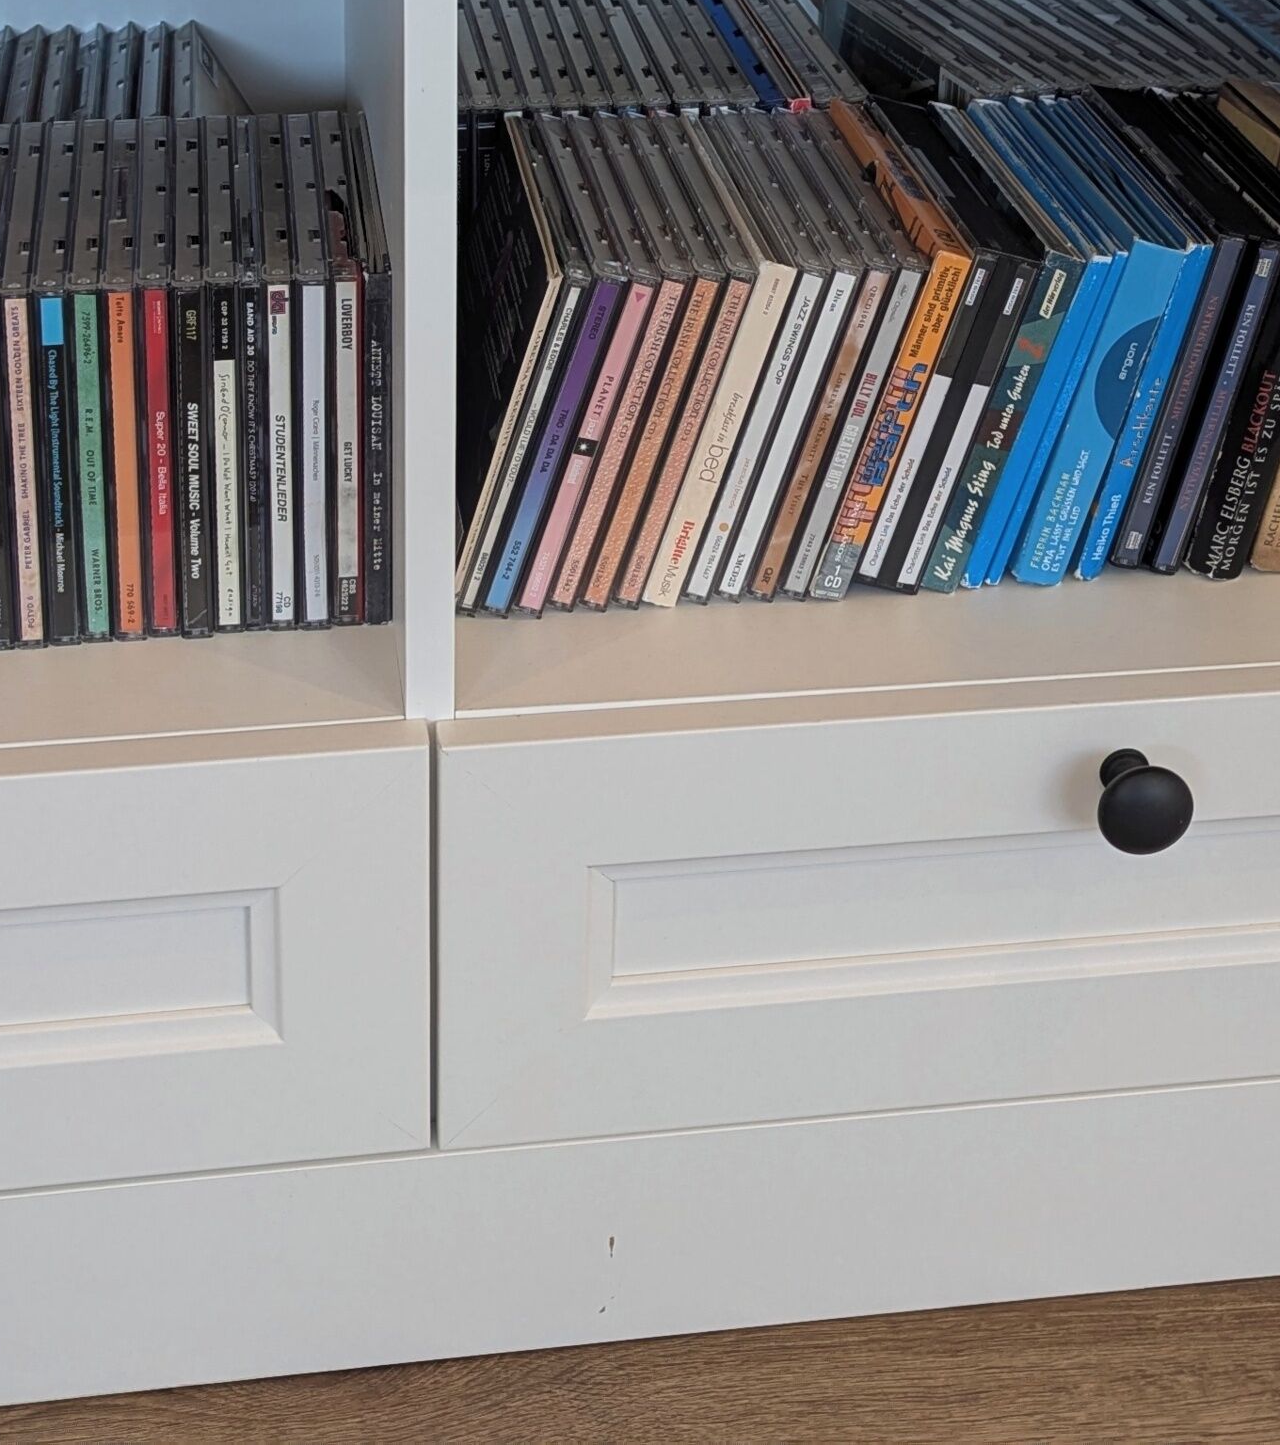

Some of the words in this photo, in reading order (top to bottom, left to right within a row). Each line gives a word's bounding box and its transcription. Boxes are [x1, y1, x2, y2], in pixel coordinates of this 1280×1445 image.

[245, 301, 253, 326] BAND
[587, 303, 607, 341] STEREO
[795, 294, 812, 322] JAZZ
[907, 322, 929, 359] Männer
[921, 301, 937, 323] sind
[930, 262, 953, 302] primitiv,
[1240, 302, 1256, 328] KEN
[246, 328, 254, 342] AID
[340, 298, 352, 350] LOVERBOY
[930, 311, 945, 334] aber
[246, 344, 254, 355] 30
[780, 321, 802, 362] SWINGS
[1224, 328, 1248, 377] FOLLETT
[47, 349, 57, 378] Chased
[247, 360, 254, 372] DO
[772, 362, 786, 385] POP
[1116, 339, 1140, 382] argon
[49, 391, 58, 405] The
[591, 373, 615, 417] PLANET
[858, 370, 878, 398] BILLY
[48, 406, 59, 427] Light
[186, 402, 198, 440] SWEET
[716, 390, 744, 434] breakfast
[849, 397, 869, 421] IDOL
[154, 410, 165, 439] Super
[716, 432, 728, 444] in
[1260, 416, 1278, 440] ZU
[156, 443, 166, 455] 20
[343, 441, 352, 456] GET
[831, 422, 859, 469] GREATEST
[984, 427, 1006, 452] Tod
[86, 449, 94, 467] OUT
[187, 442, 198, 472] SOUL
[275, 414, 287, 521] STUDENTENLIEDER
[696, 441, 729, 486] bed
[1141, 480, 1157, 505] KEN
[1149, 431, 1174, 480] FOLLETT
[1253, 444, 1270, 464] ES
[87, 471, 95, 483] OF
[343, 457, 352, 482] LUCKY
[823, 467, 843, 491] HITS
[964, 456, 998, 498] Sting
[1203, 520, 1232, 569] MARC
[1218, 454, 1252, 520] ELSBERG
[1238, 368, 1278, 454] BLACKOUT
[88, 486, 96, 505] TIME
[188, 474, 199, 510] MUSIC
[1242, 469, 1262, 497] IST
[22, 509, 30, 542] GABRIEL
[942, 494, 982, 555] Magnus
[1028, 524, 1052, 569] FREDRIK
[1045, 471, 1072, 523] BACKMAN
[1090, 525, 1111, 562] Heiko
[1101, 491, 1123, 528] Thieß
[55, 532, 64, 562] Michael
[189, 518, 200, 555] Volume
[1050, 560, 1061, 573] ES
[1067, 503, 1082, 526] LEID
[1218, 500, 1252, 572] MORGEN
[24, 544, 32, 569] PETER
[91, 548, 100, 585] WARNER
[190, 558, 201, 578] Two
[931, 552, 958, 582] Kai
[1039, 546, 1056, 572] OMA
[56, 565, 66, 593] Monroe
[824, 574, 842, 588] CD
[283, 596, 290, 607] CD
